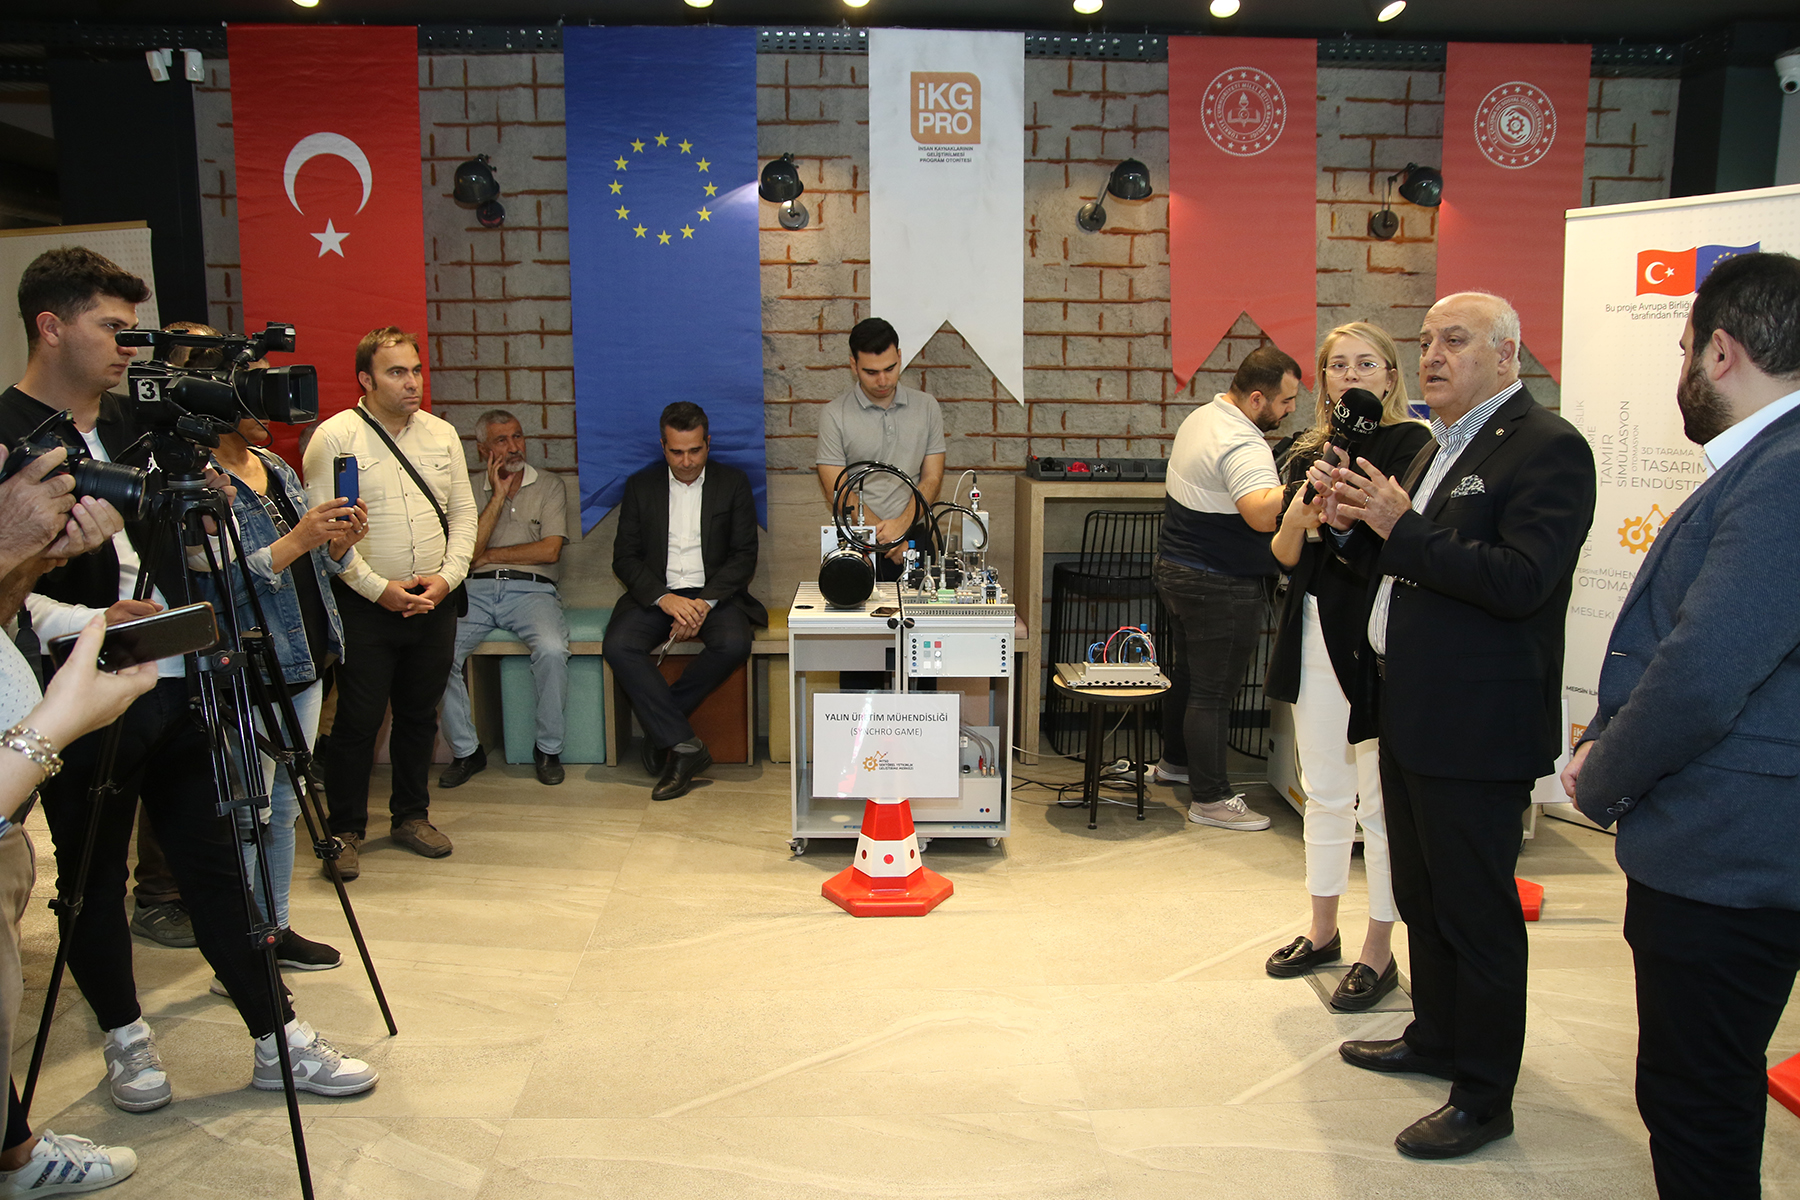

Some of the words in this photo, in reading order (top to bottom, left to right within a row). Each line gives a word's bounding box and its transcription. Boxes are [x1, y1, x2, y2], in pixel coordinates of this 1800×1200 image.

[918, 82, 973, 110] iKG
[918, 112, 972, 134] PRO
[1605, 304, 1615, 312] Bu
[1617, 303, 1637, 313] proje
[1638, 302, 1667, 312] Avrupa
[1631, 310, 1672, 320] tarafından
[141, 380, 156, 400] 3
[1616, 401, 1630, 487] SİMÜLASYON
[1640, 446, 1654, 455] 3D
[1656, 447, 1694, 456] TARAMA
[1600, 434, 1614, 486] TAMİR
[1570, 606, 1615, 620] MESLEKİ
[1566, 685, 1588, 694] MERSİN
[824, 713, 850, 722] YALIN
[852, 712, 884, 722] ÜRTİM
[886, 712, 948, 722] MÜHENDİSLİĞİ
[894, 728, 923, 737] GAME)
